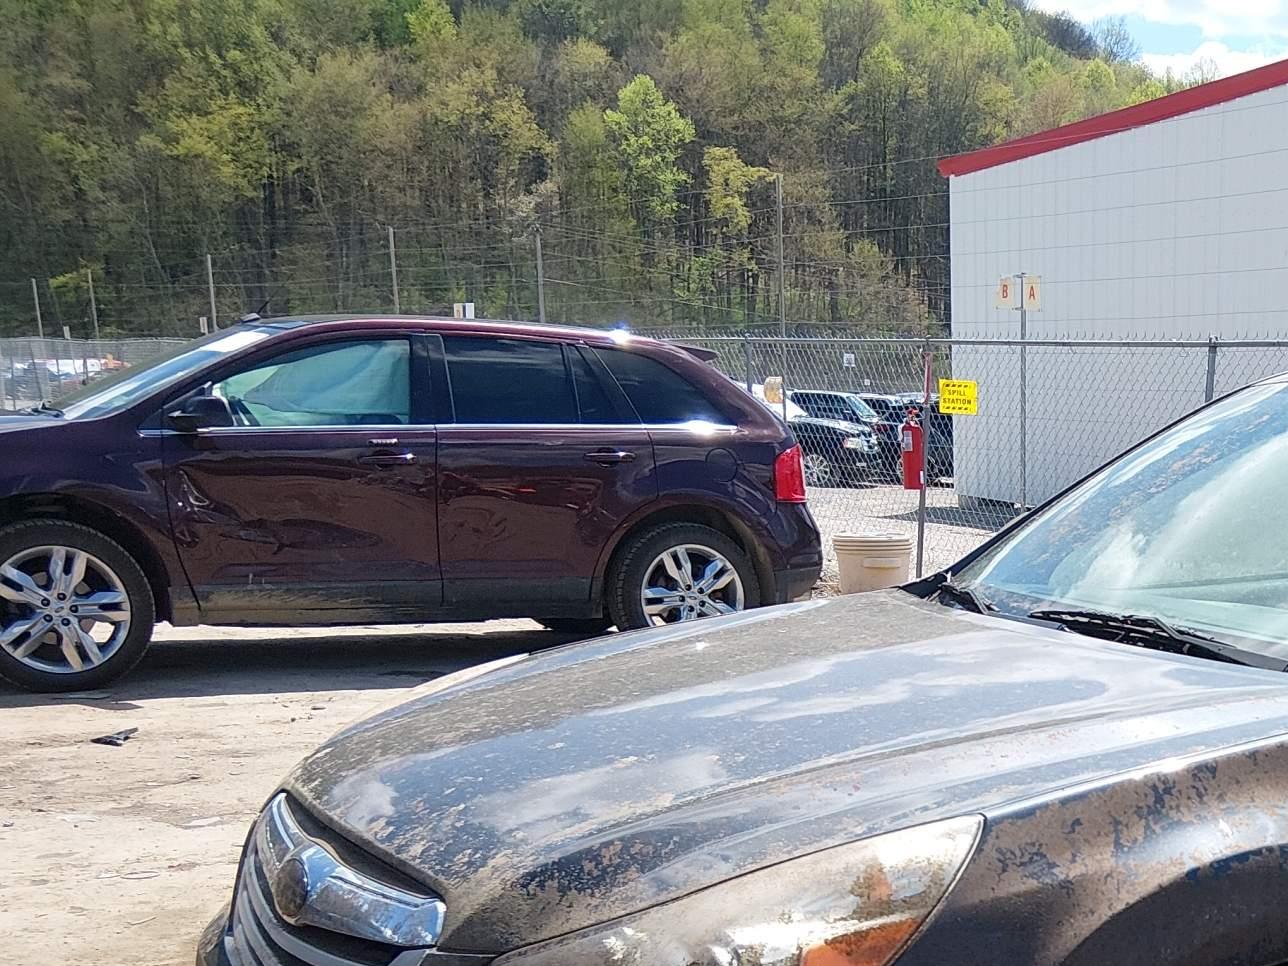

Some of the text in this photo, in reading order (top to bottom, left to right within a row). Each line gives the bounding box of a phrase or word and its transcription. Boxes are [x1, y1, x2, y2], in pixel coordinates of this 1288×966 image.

[1002, 284, 1008, 298] B
[1028, 285, 1036, 300] A
[942, 397, 972, 405] STATION
